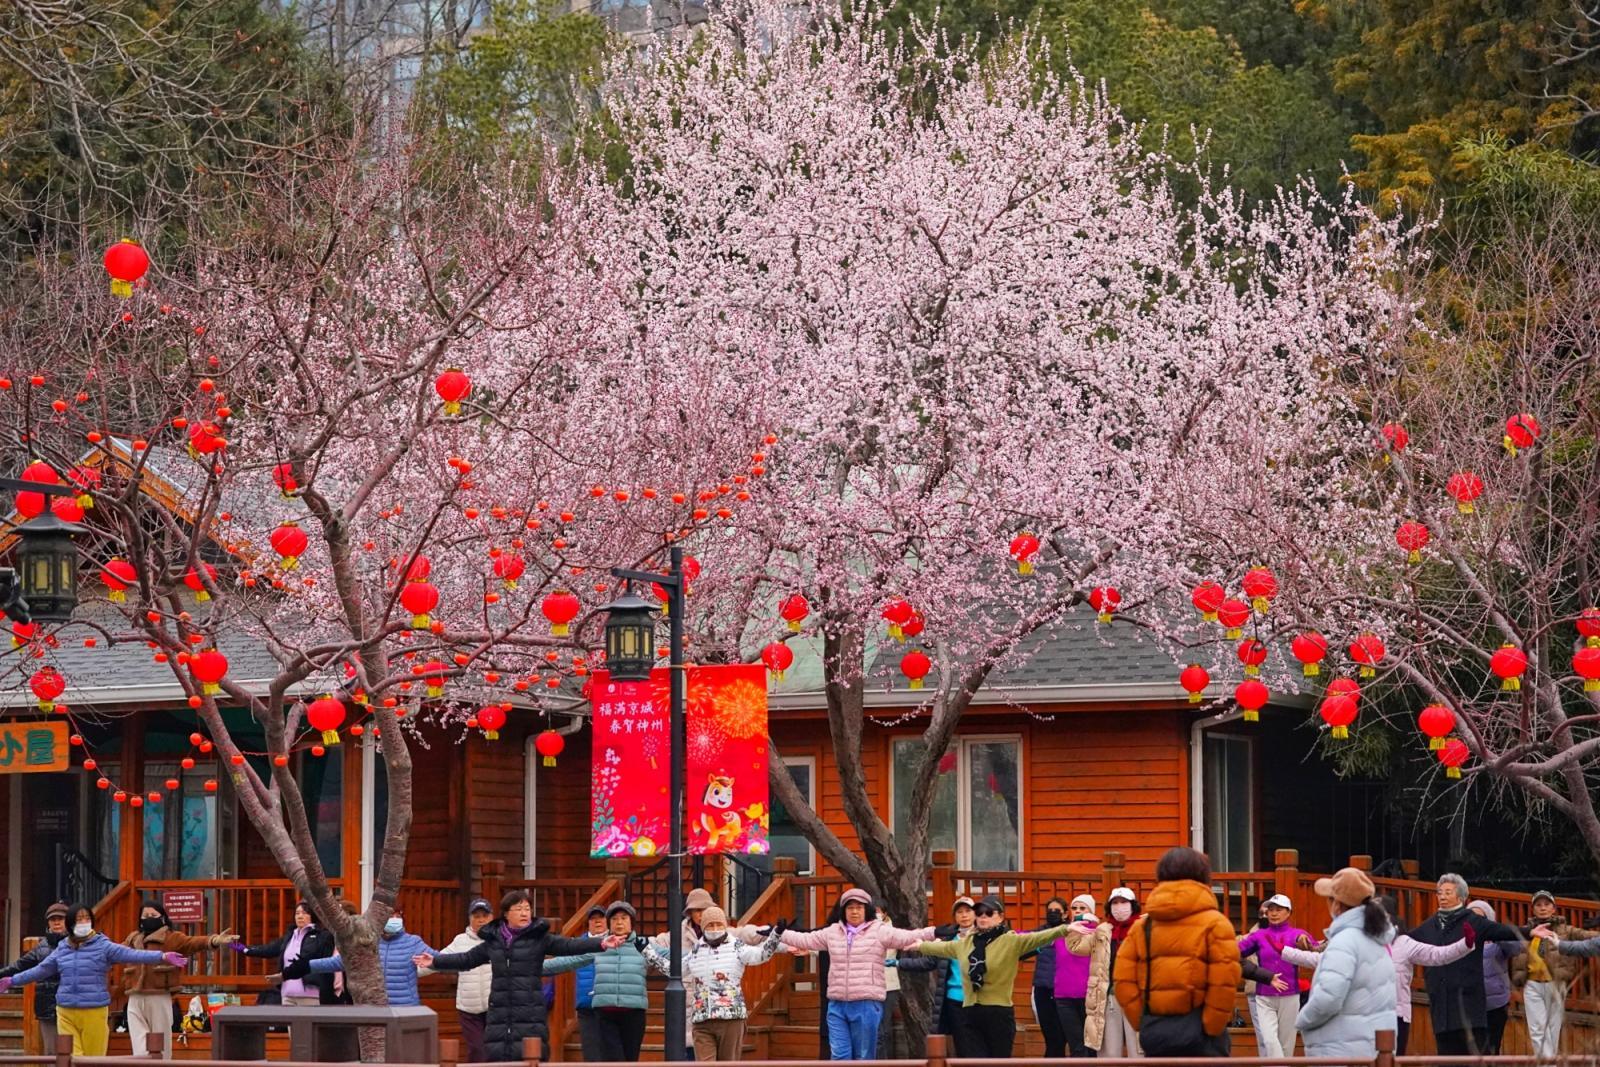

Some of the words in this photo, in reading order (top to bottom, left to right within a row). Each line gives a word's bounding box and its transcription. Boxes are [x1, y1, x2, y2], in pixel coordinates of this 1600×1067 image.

[599, 701, 654, 717] 福满京城
[609, 718, 663, 734] 春贺神州
